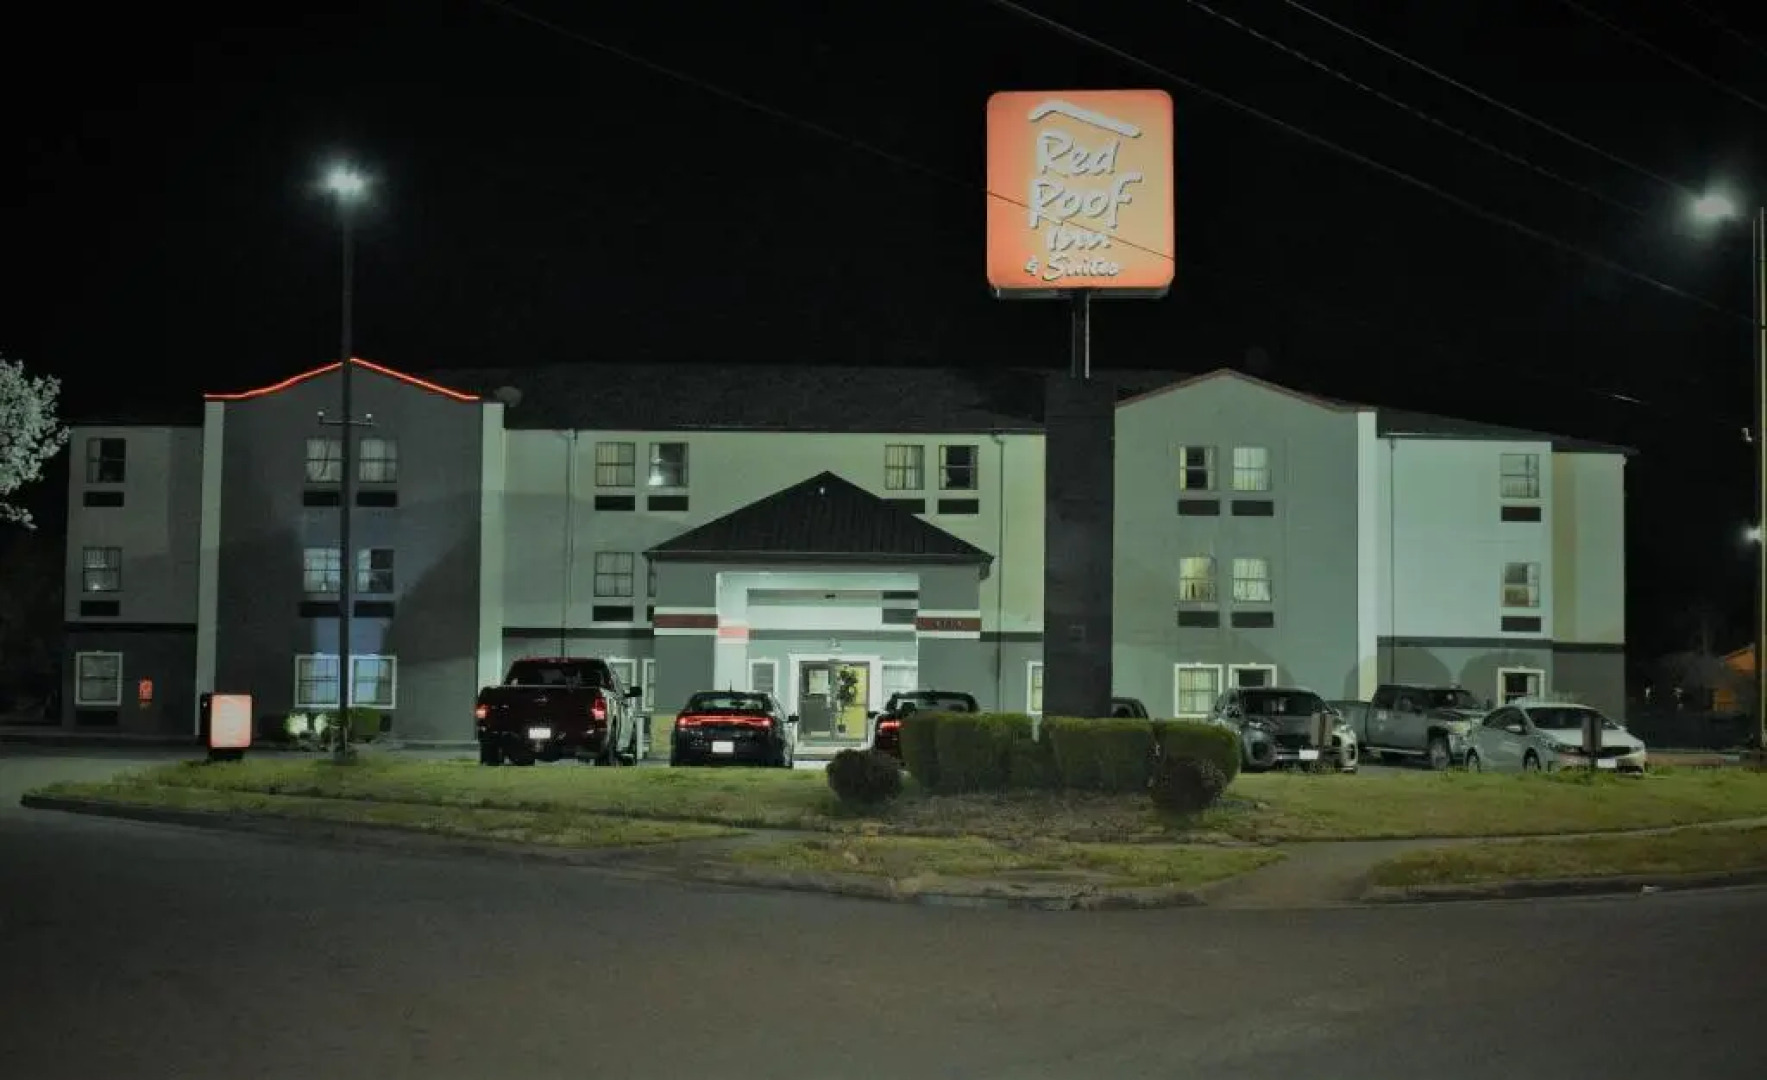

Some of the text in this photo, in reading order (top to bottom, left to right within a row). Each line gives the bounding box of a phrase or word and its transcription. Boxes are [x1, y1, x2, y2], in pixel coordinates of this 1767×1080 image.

[1037, 130, 1121, 177] Red
[1028, 171, 1143, 229] Roof
[1045, 227, 1112, 252] Inn
[1042, 252, 1121, 281] Suites
